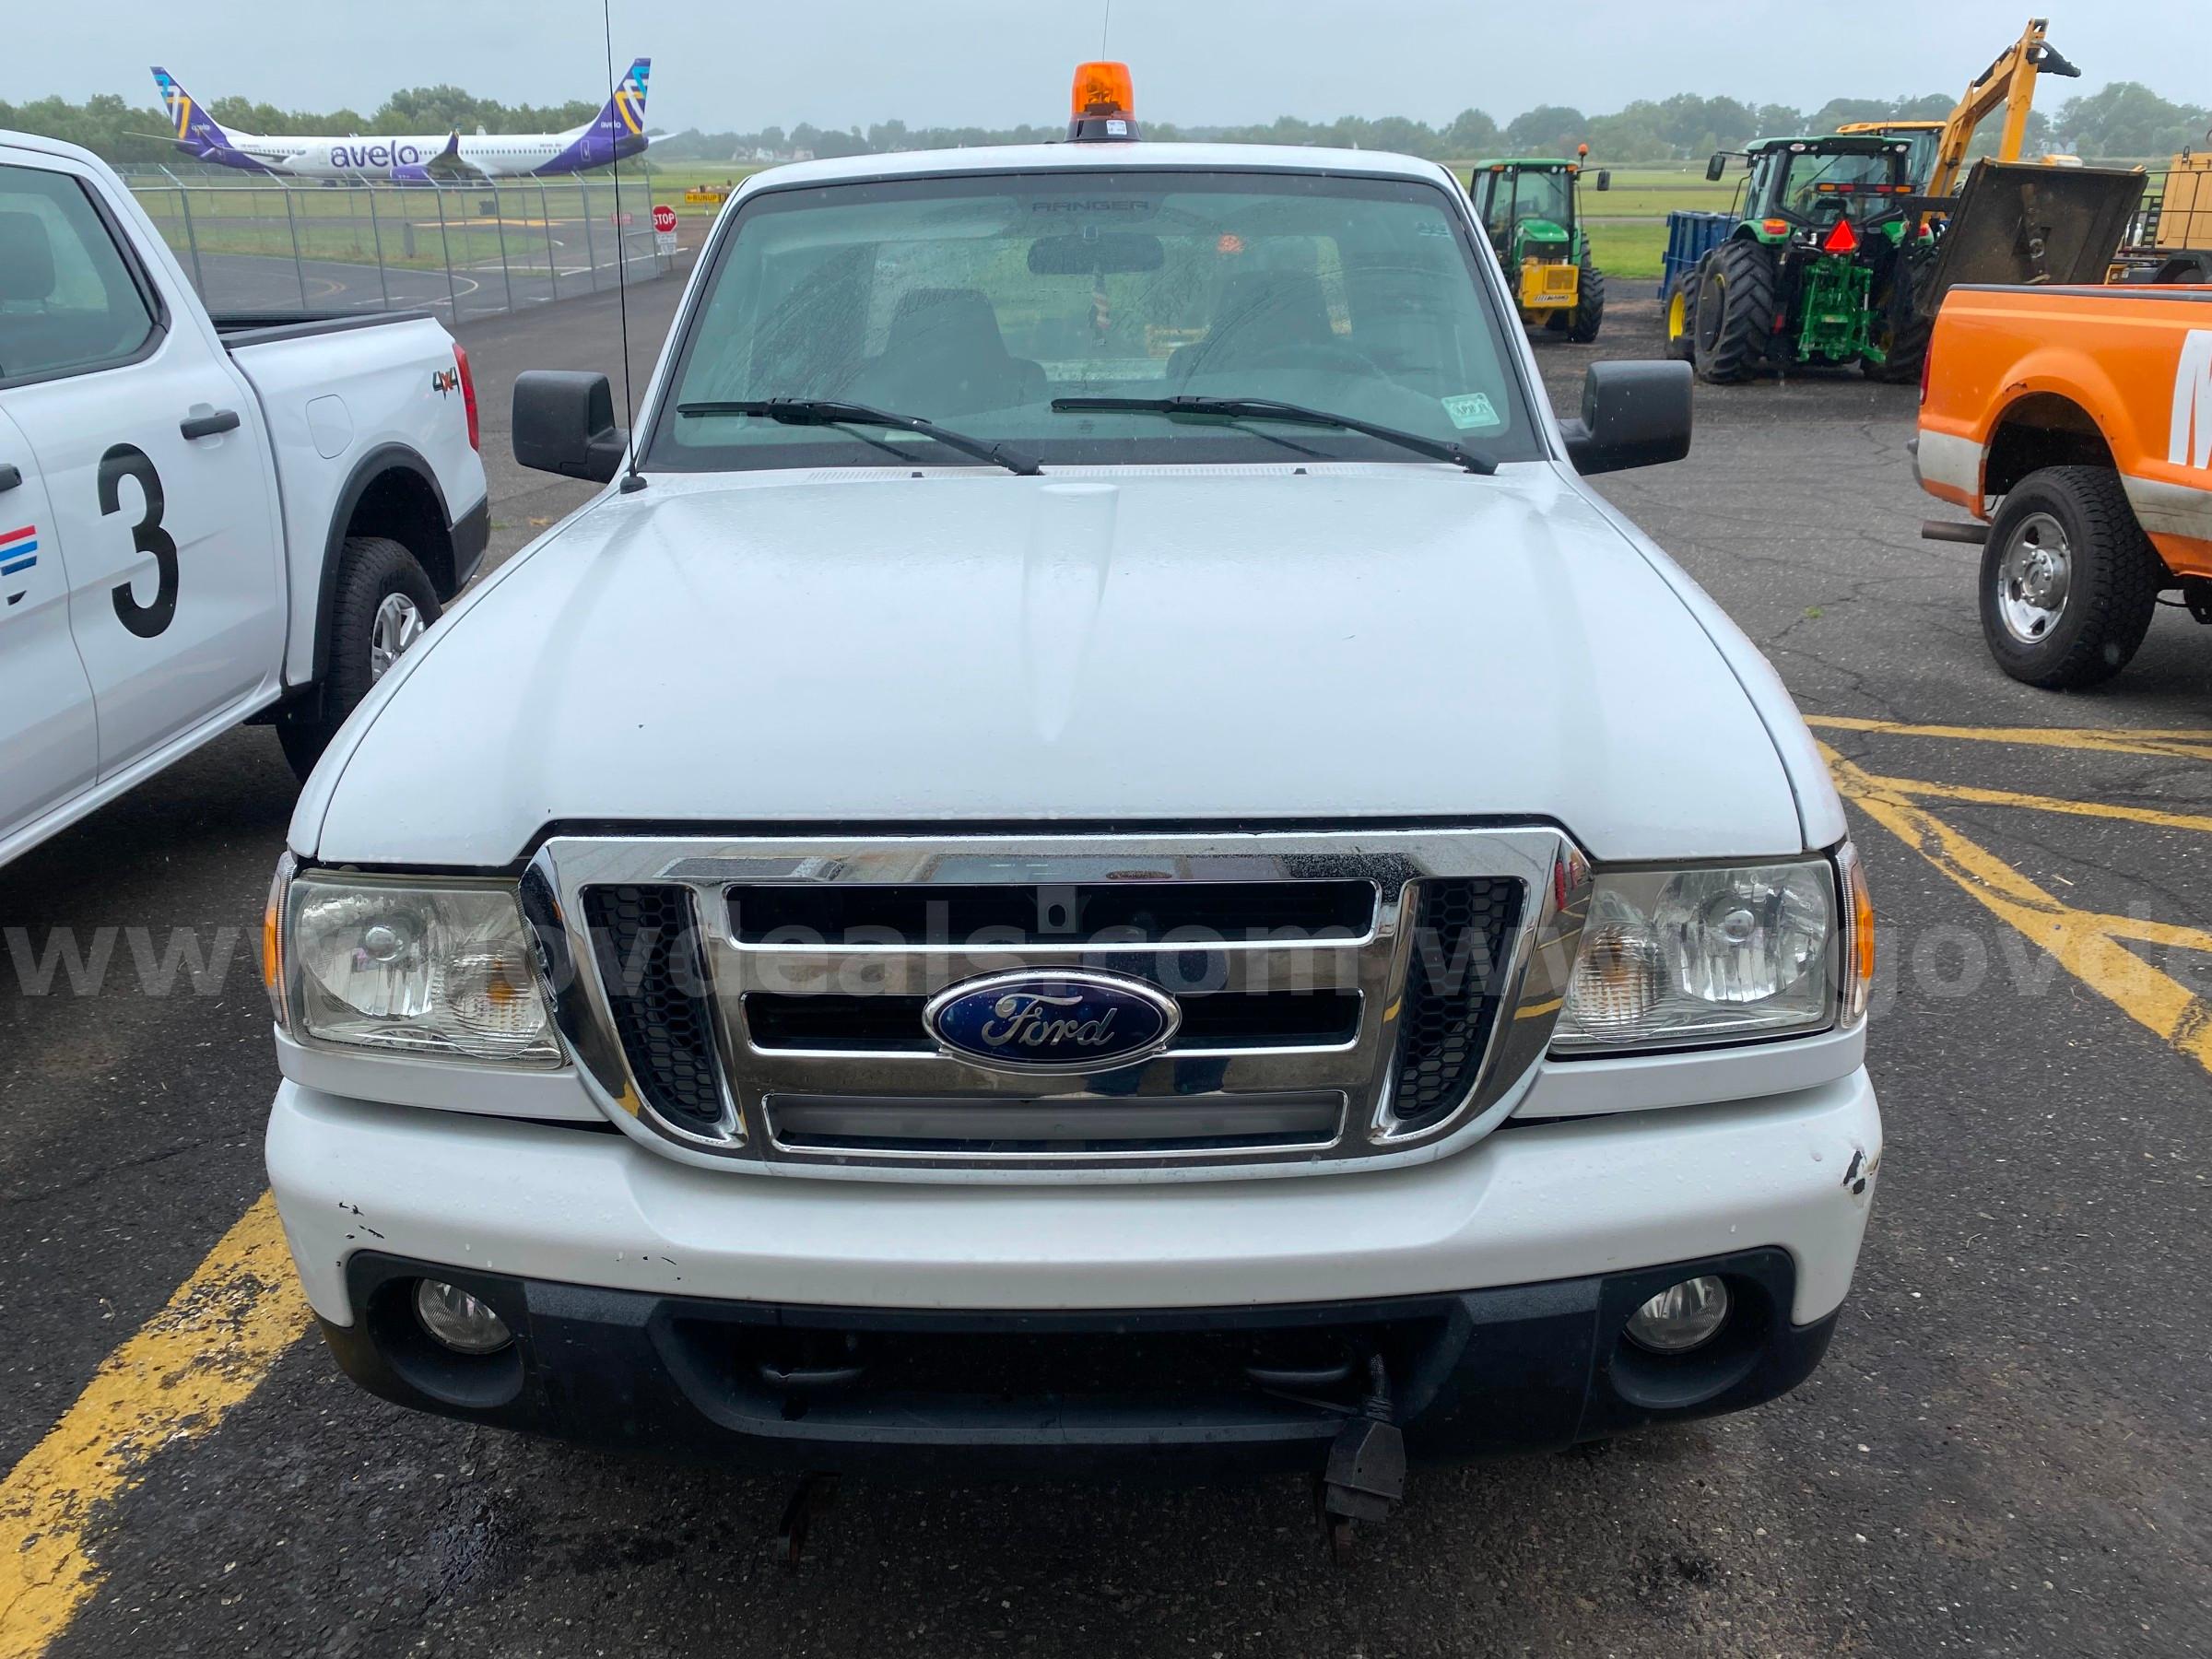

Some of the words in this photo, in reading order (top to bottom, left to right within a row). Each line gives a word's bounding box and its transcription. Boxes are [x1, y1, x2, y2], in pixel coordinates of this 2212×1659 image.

[331, 139, 418, 167] avelo
[653, 213, 675, 226] STOP
[1031, 201, 1149, 212] RANGER
[97, 442, 179, 638] 3
[982, 993, 1117, 1046] Ford
